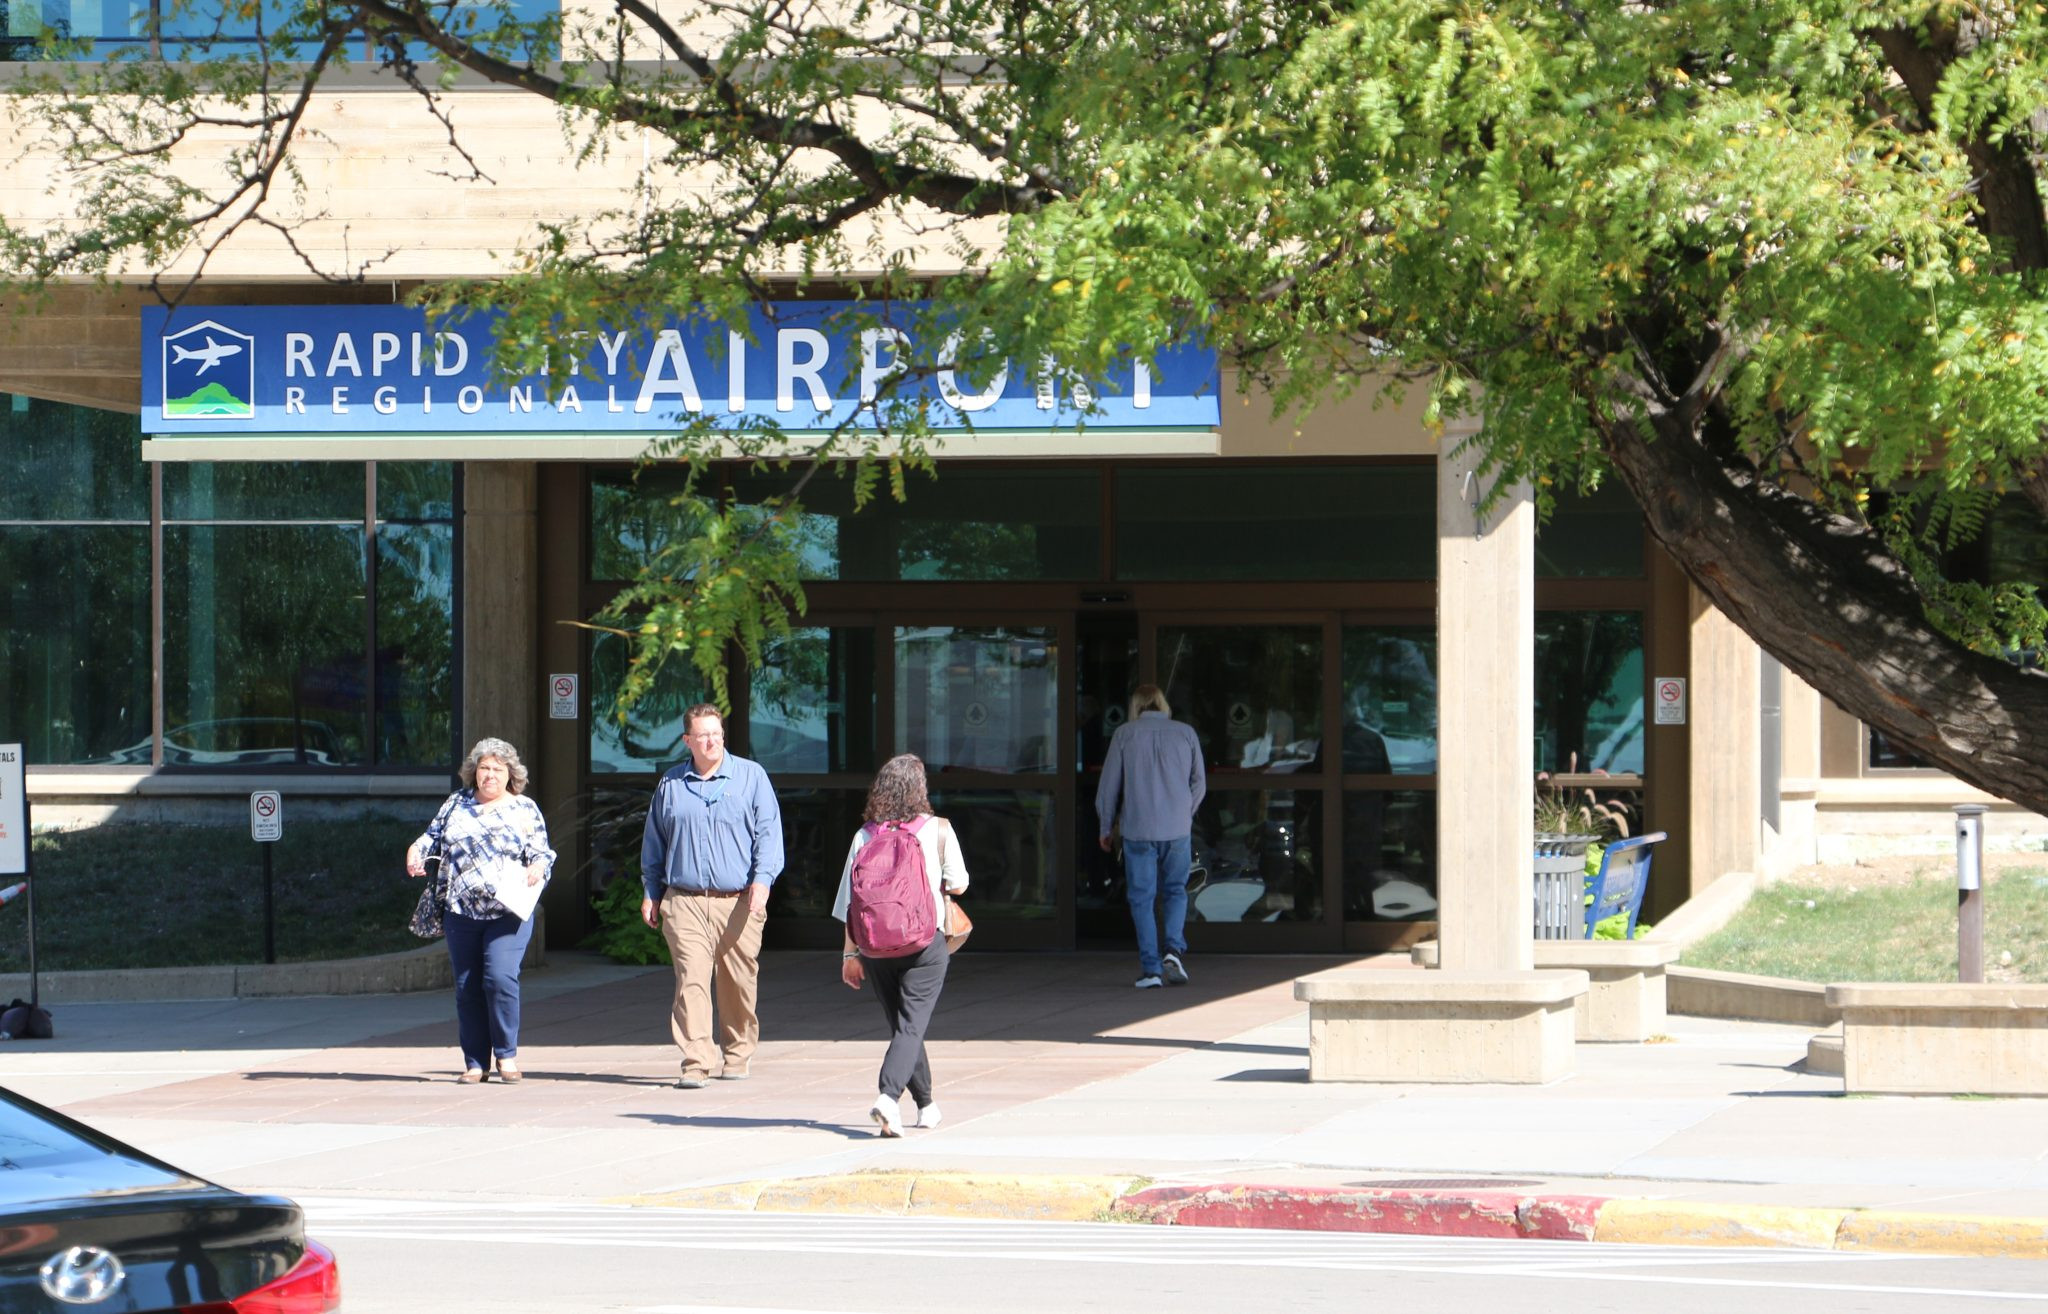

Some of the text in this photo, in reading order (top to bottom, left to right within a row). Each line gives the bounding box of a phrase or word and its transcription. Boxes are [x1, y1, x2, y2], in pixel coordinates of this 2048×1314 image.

[286, 330, 628, 377] RAPID TY
[286, 385, 624, 414] REGIONAL
[0, 751, 15, 763] ALS
